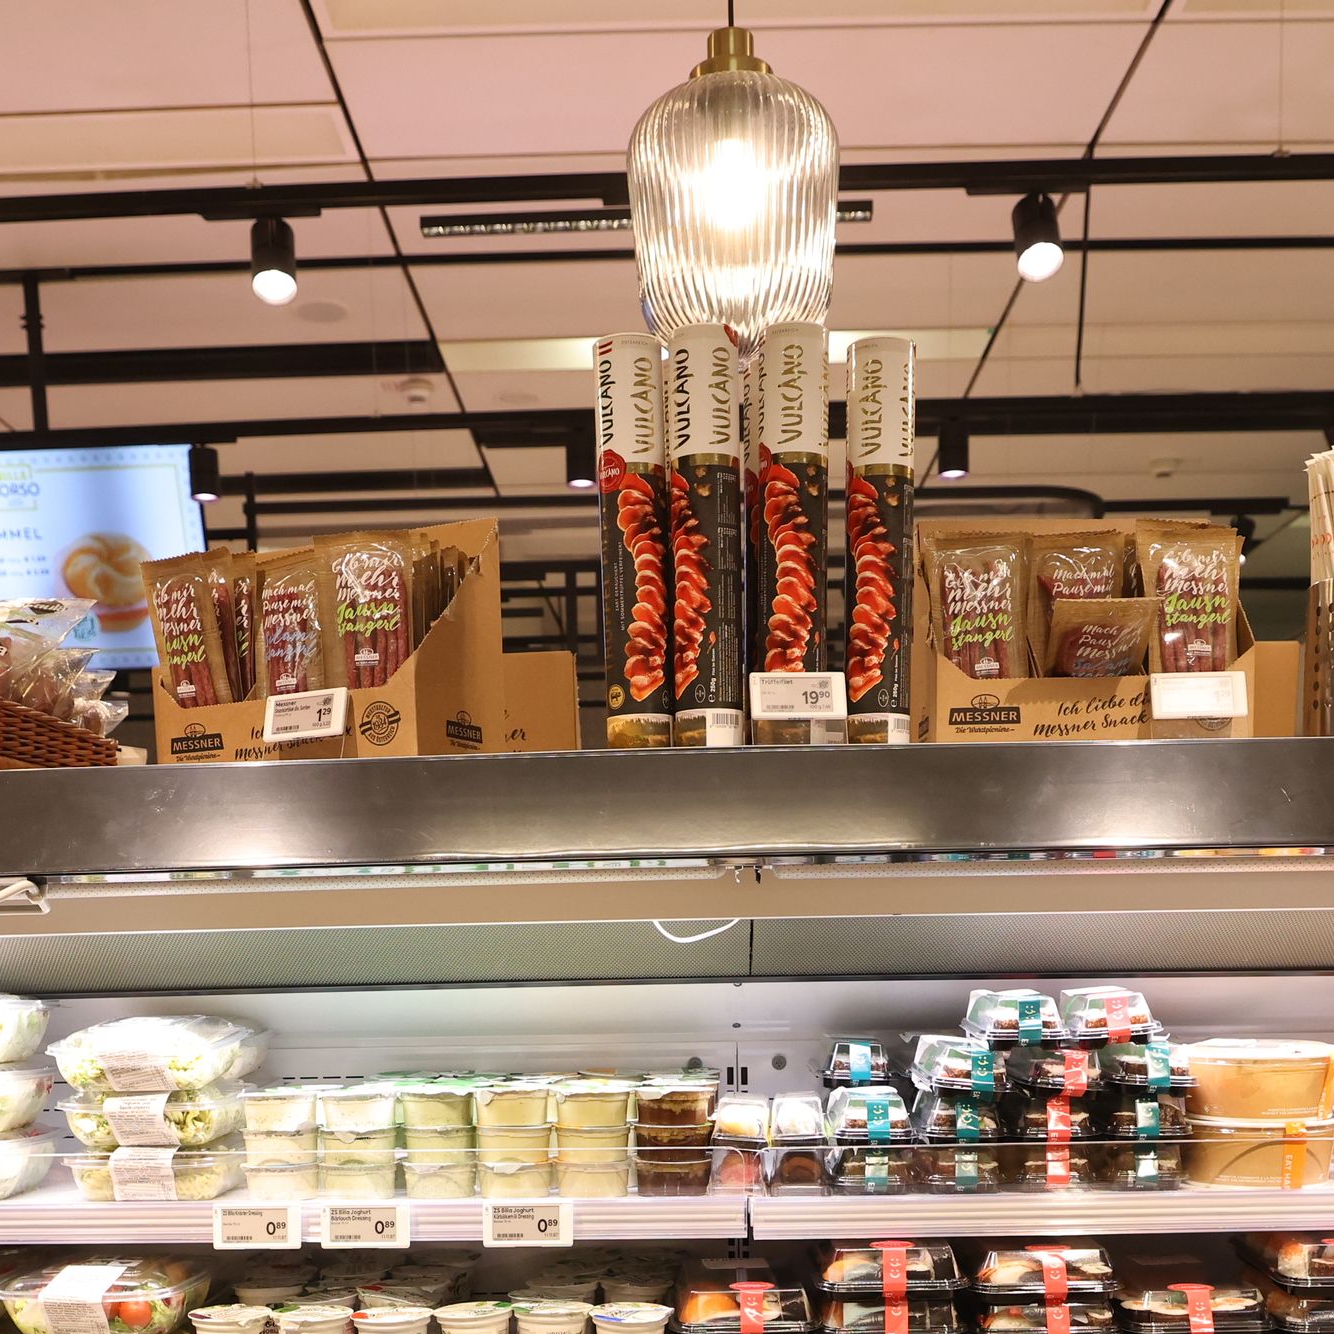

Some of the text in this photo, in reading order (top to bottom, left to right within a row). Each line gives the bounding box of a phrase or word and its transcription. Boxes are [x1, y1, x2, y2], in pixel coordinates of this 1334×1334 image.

[599, 357, 617, 449] VULCANO
[632, 356, 657, 455] VULCANO
[671, 347, 693, 452] VULCANO
[708, 345, 735, 446] VULCANO
[777, 342, 808, 445] VULCANO
[857, 357, 888, 459] VULCANO
[952, 625, 1015, 651] stangerl
[1166, 610, 1231, 629] stangerl
[447, 722, 481, 741] MESSNER
[952, 711, 1017, 722] MESSNER
[1057, 693, 1126, 717] Ich liebe
[172, 738, 221, 753] MESSNER
